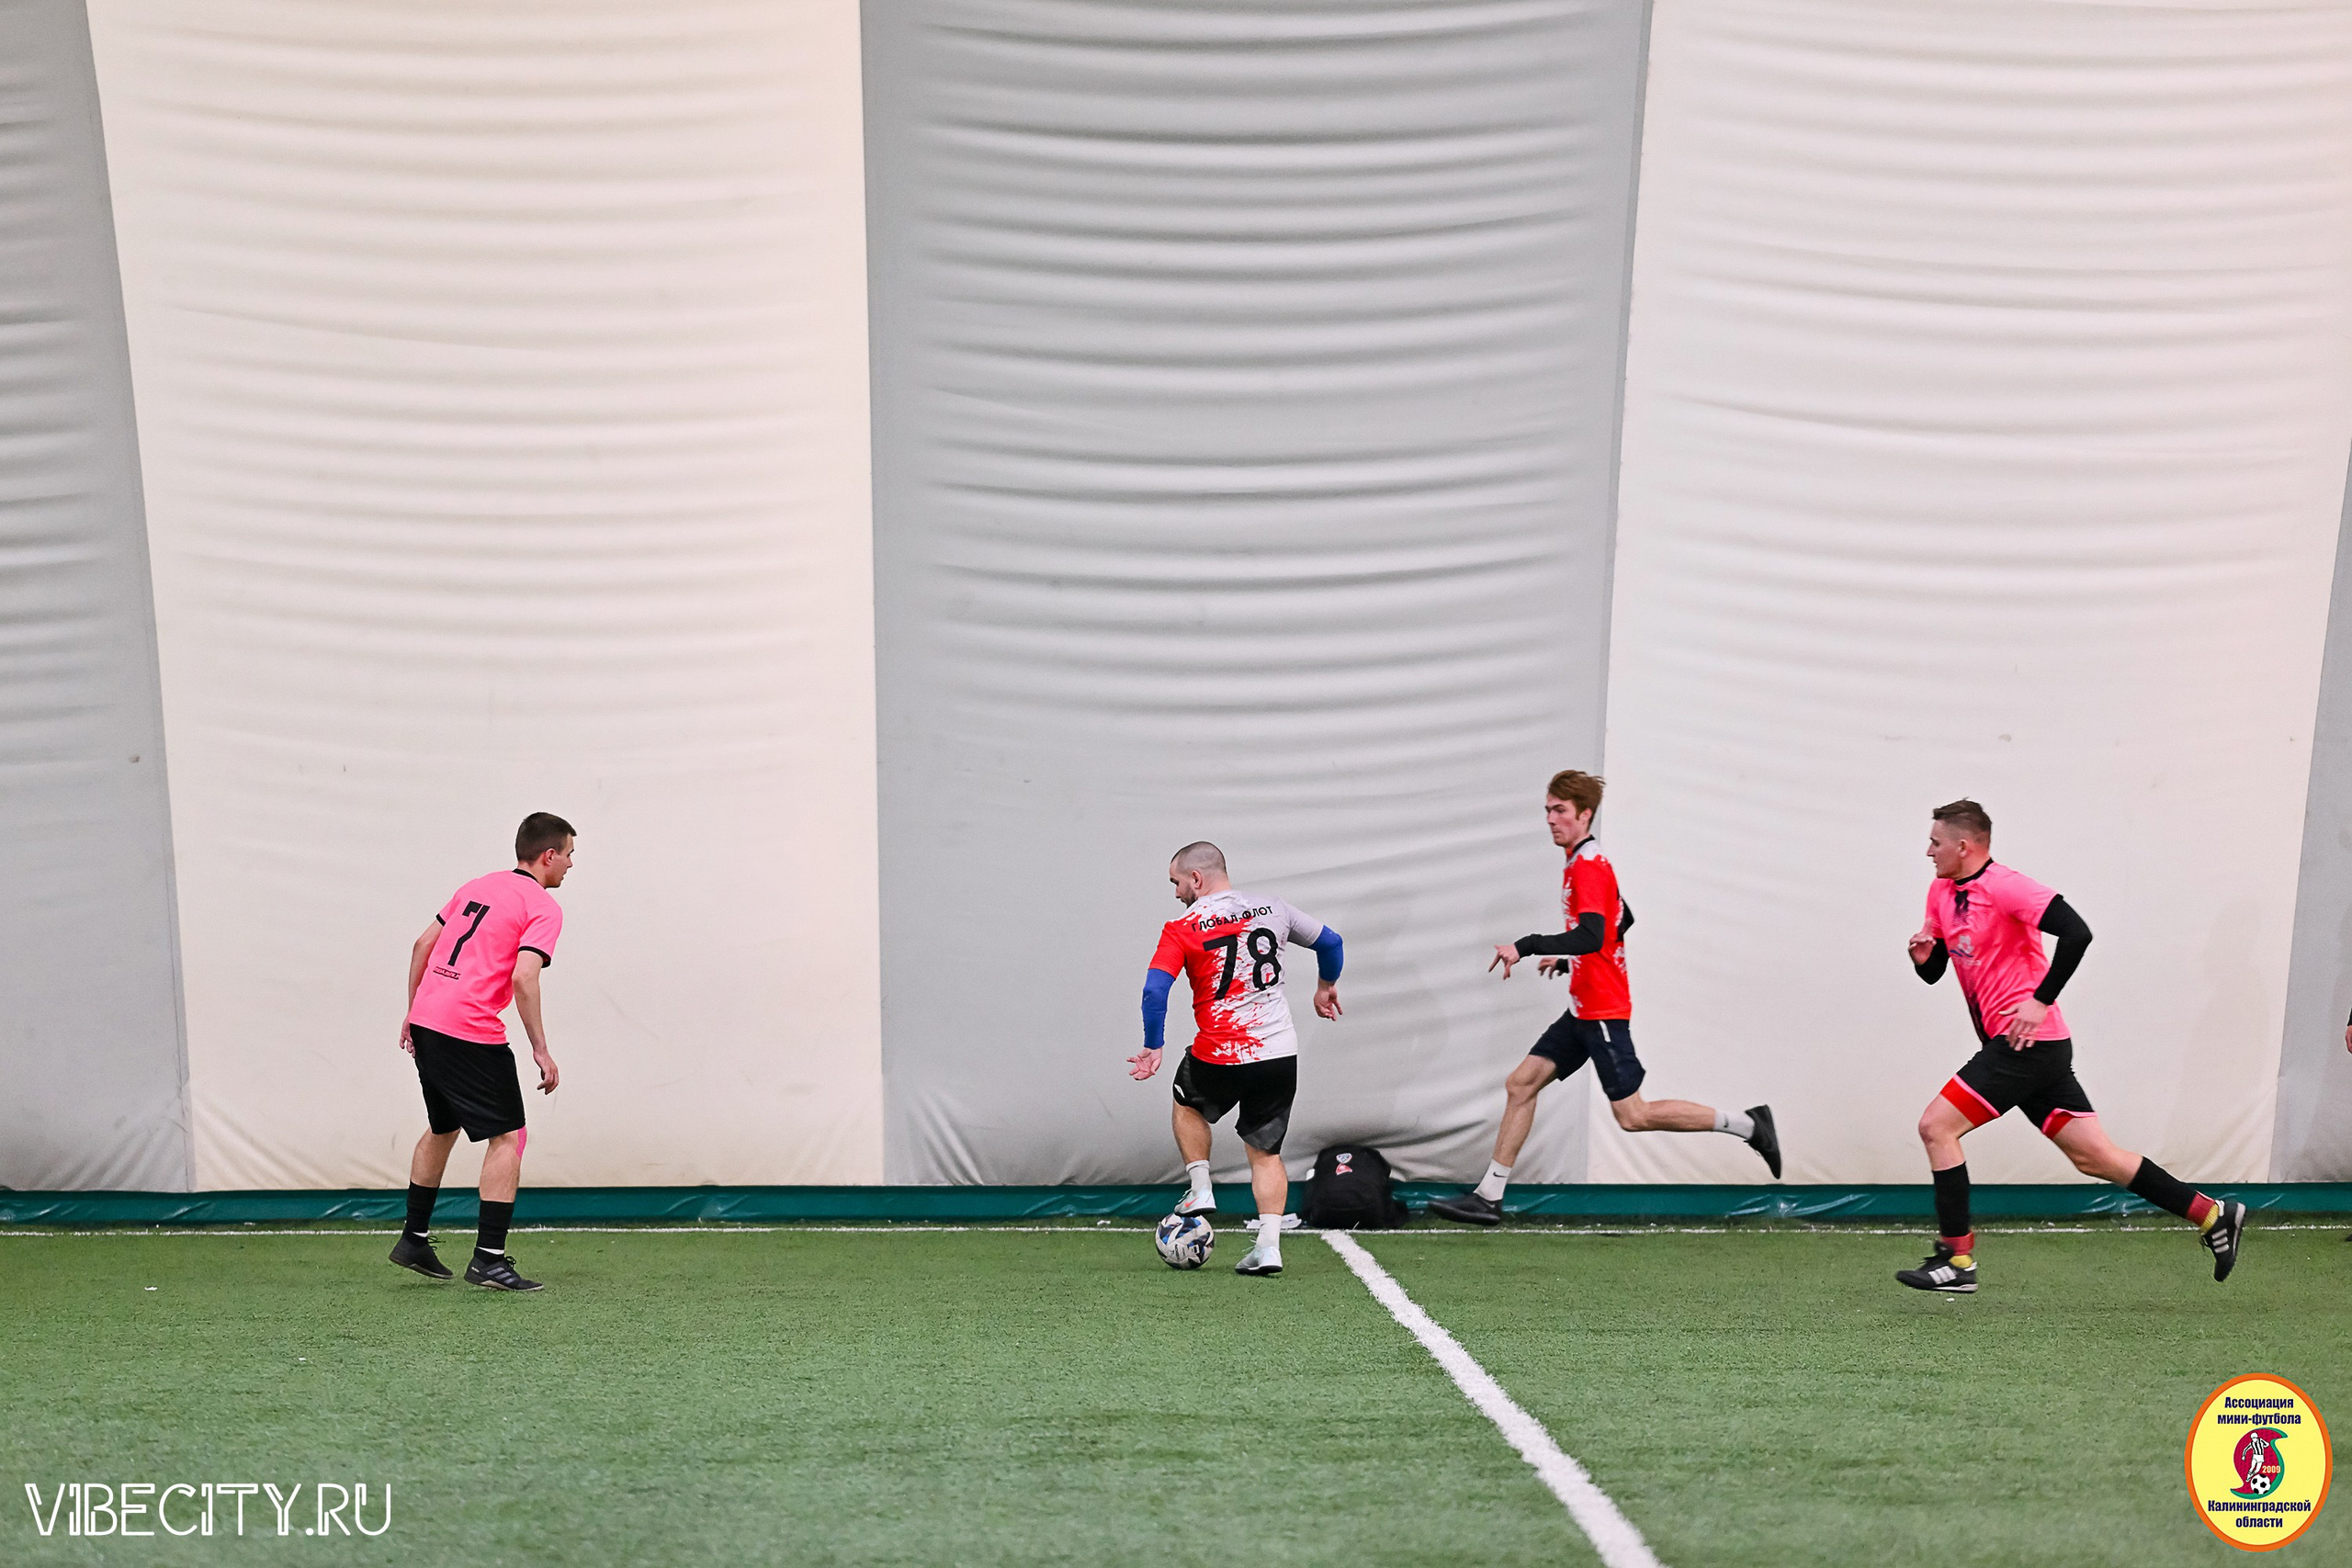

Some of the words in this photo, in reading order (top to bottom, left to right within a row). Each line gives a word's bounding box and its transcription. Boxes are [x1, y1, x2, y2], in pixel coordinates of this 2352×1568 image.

[447, 900, 491, 965] 7
[1192, 906, 1272, 931] ГЛОБАЛ-ФЛОТ
[1204, 927, 1281, 999] 78
